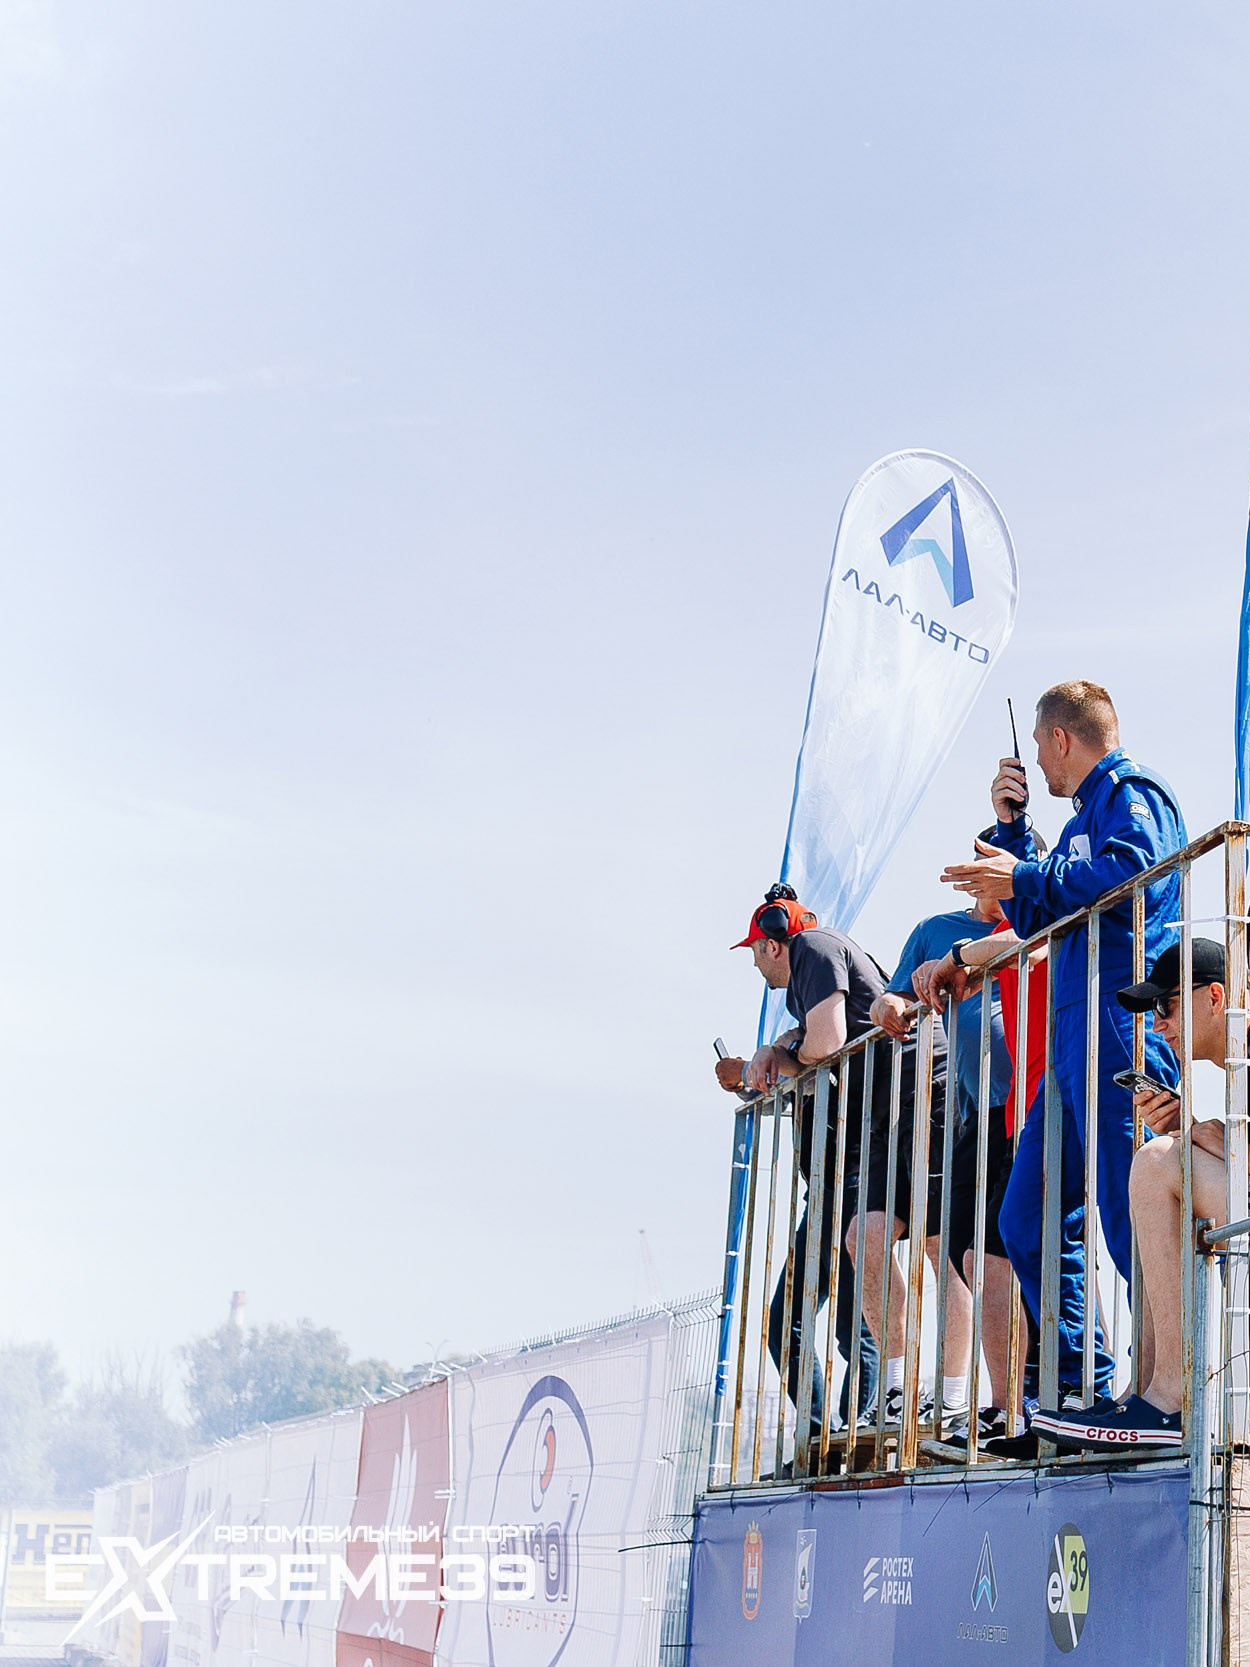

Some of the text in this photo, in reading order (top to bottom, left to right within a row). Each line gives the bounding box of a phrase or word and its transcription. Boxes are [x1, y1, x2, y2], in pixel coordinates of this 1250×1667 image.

[1086, 1427, 1140, 1443] crocs
[882, 1556, 915, 1578] РОСТЕХ
[880, 1581, 913, 1605] АРЕНА
